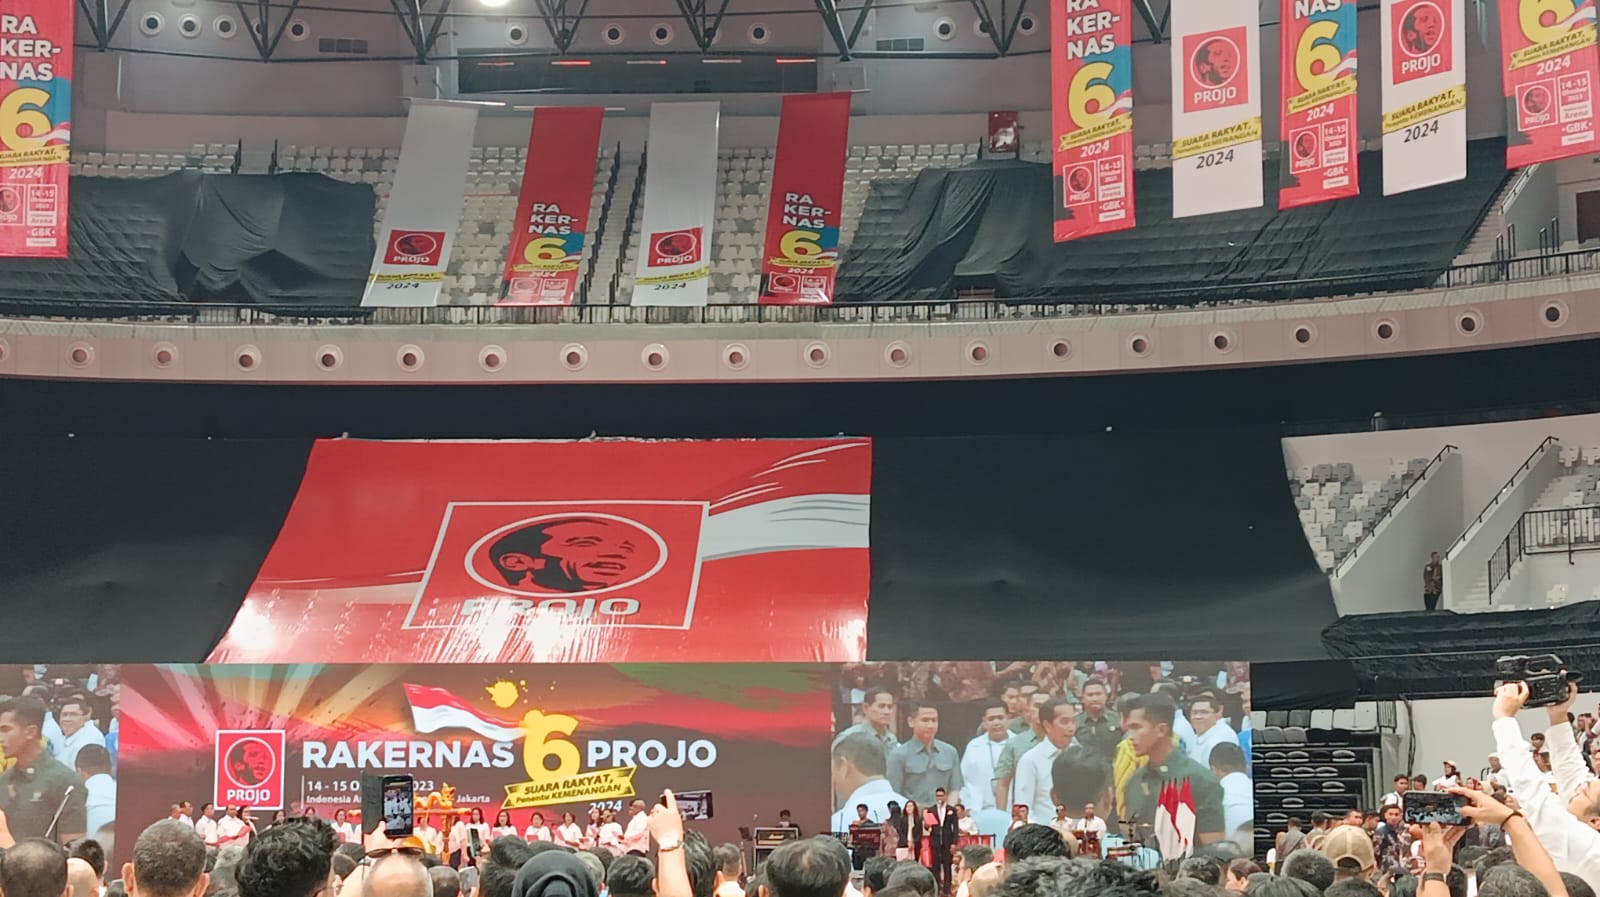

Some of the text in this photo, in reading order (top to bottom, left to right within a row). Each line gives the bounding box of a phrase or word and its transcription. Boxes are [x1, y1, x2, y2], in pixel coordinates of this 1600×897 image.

[1067, 0, 1099, 13] RA
[1295, 0, 1341, 19] NAS
[2, 15, 37, 34] RA
[1067, 11, 1121, 37] KER-
[1519, 0, 1576, 44] 6
[0, 39, 61, 58] KER-
[1067, 34, 1115, 60] NAS
[1295, 20, 1342, 91] 6
[0, 62, 53, 81] NAS
[1402, 54, 1441, 74] PROJO
[1536, 55, 1571, 75] 2024
[1067, 61, 1116, 128] 6
[1194, 86, 1237, 104] PROJO
[1306, 103, 1335, 122] 2024
[1392, 90, 1456, 120] SUARA RAKYAT,
[0, 87, 53, 150] 6
[1182, 122, 1252, 147] SUARA RAKYAT,
[1404, 120, 1438, 143] 2024
[1080, 140, 1110, 158] 2024
[1196, 149, 1234, 169] 2024
[8, 167, 43, 180] 2024
[786, 193, 813, 204] RA
[533, 204, 560, 213] RA
[784, 204, 832, 217] KER-
[530, 215, 578, 224] KER-
[783, 215, 825, 229] NAS
[528, 225, 571, 235] NAS
[524, 237, 567, 266] 6
[780, 230, 822, 260] 6
[393, 256, 430, 264] PROJO
[656, 255, 693, 265] PROJO
[386, 282, 420, 290] 2024
[303, 709, 717, 781] RAKERNAS 6 PROJO
[307, 781, 322, 791] 14
[333, 781, 347, 791] 15
[413, 780, 434, 791] 023
[516, 784, 621, 803] Penentu KEMENANGAN
[524, 774, 614, 795] SUARA RAKYAT,
[226, 789, 271, 805] PROJO
[306, 795, 352, 804] Indonesia
[456, 794, 491, 803] Jakarta
